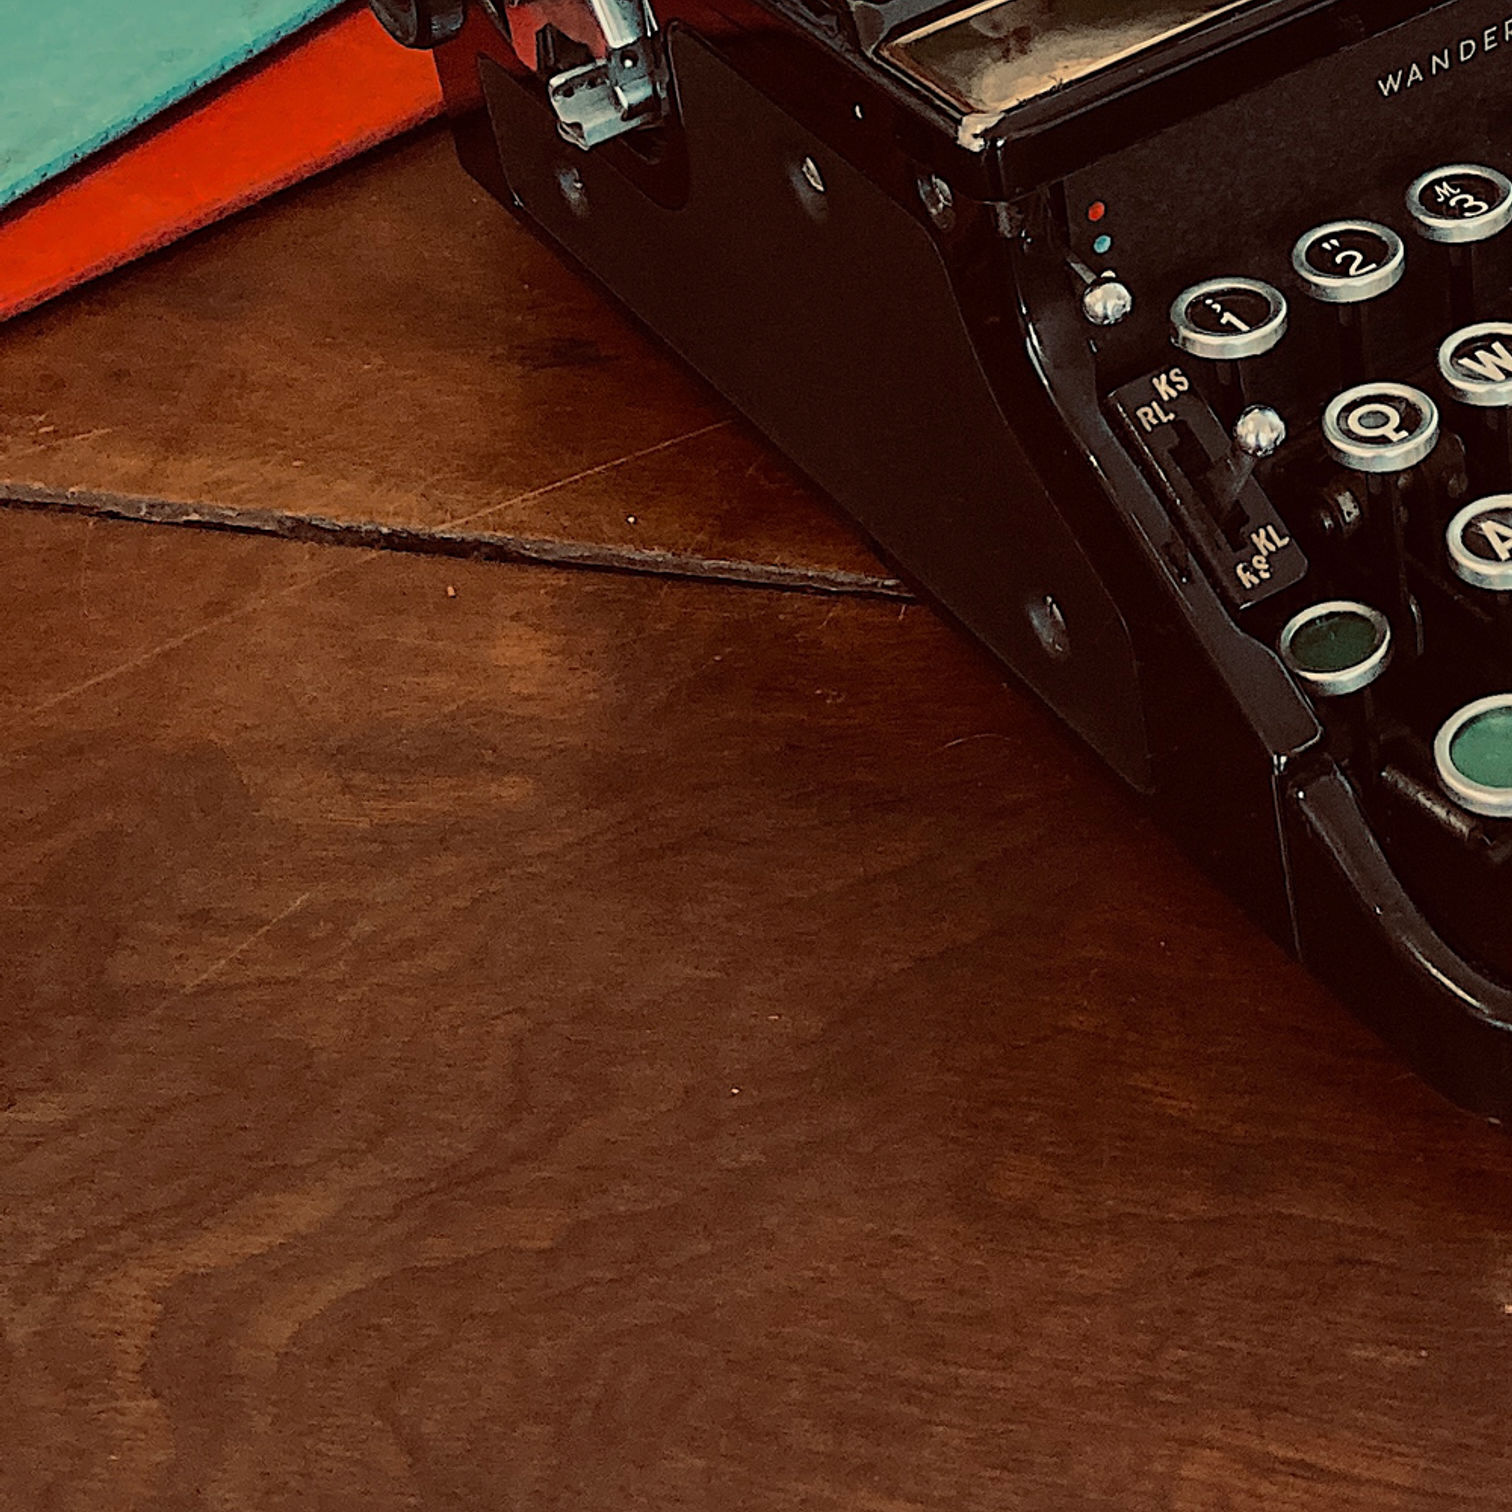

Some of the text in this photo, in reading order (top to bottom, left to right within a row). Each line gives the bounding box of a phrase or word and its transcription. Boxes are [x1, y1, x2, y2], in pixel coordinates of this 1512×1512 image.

[1449, 194, 1489, 217] 3
[1335, 250, 1377, 276] 2
[1220, 311, 1250, 332] 1
[1152, 367, 1189, 402] KS
[1136, 401, 1176, 432] RL
[1347, 402, 1410, 443] Q
[1251, 525, 1290, 556] KL
